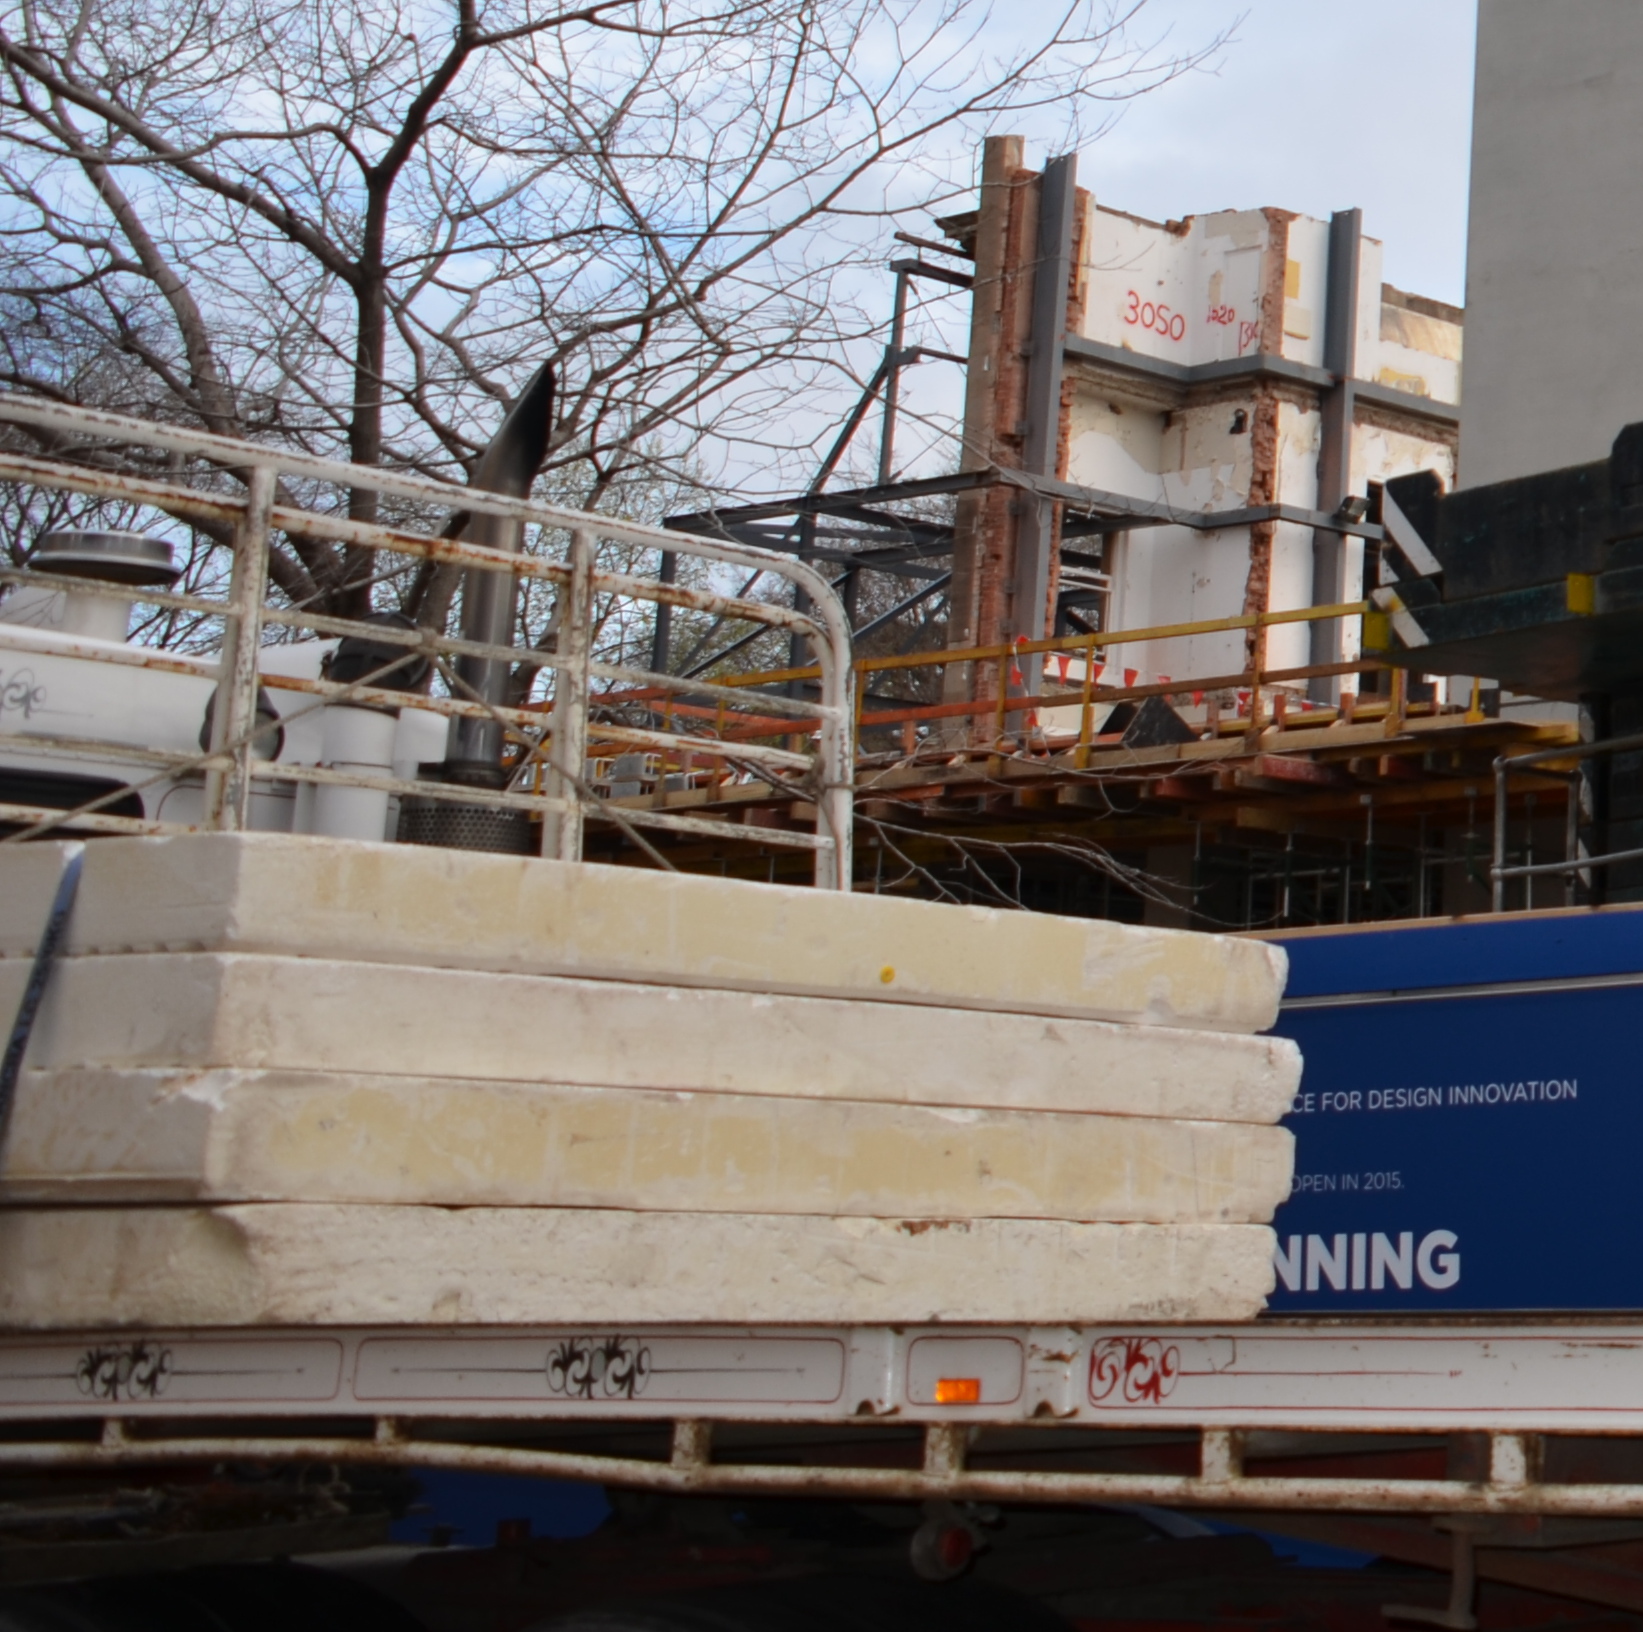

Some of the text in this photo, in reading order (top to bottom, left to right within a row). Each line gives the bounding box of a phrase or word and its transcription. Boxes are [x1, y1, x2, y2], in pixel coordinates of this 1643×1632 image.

[1321, 1091, 1362, 1112] FOR
[1368, 1086, 1443, 1110] DESIGN
[1448, 1079, 1578, 1106] INNOVATION
[1341, 1173, 1359, 1191] IN
